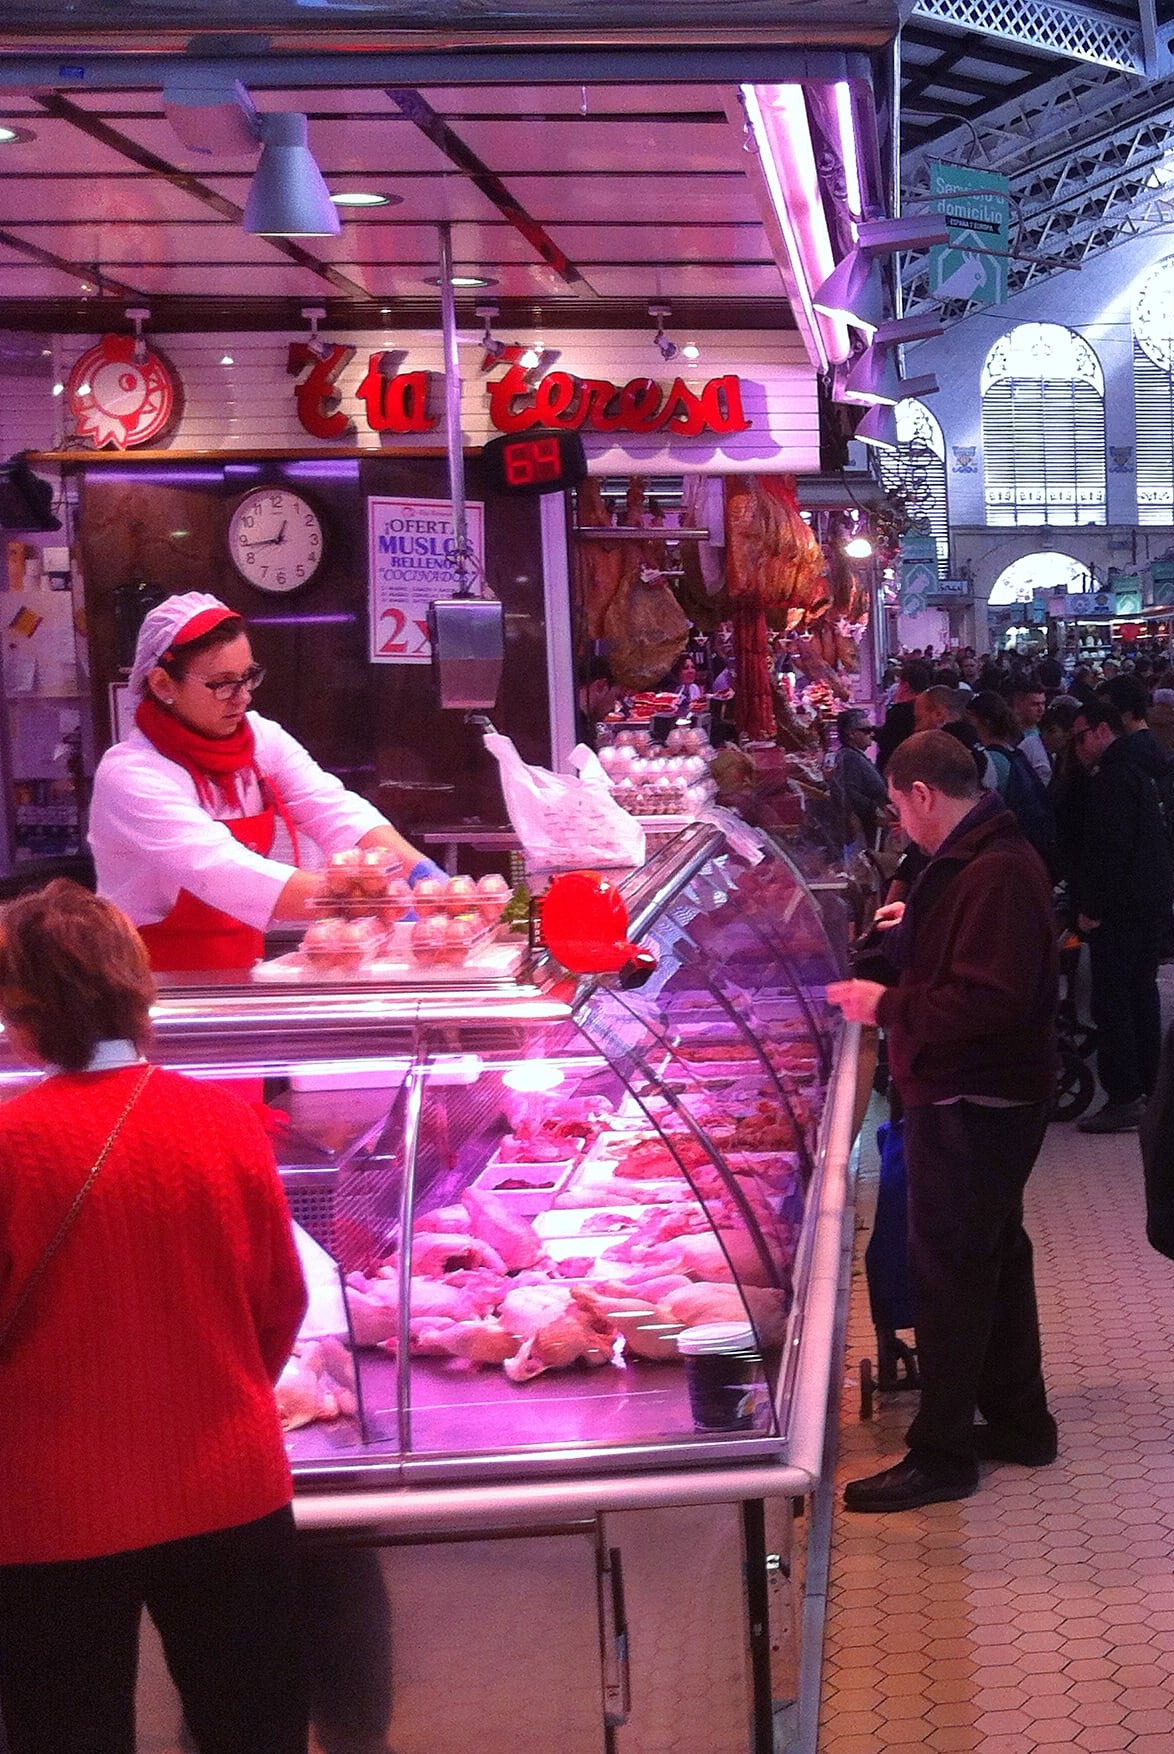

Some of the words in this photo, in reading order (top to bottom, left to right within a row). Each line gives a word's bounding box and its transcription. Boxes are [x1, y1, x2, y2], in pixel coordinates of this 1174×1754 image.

[937, 199, 1003, 224] domicilio
[482, 342, 753, 437] Teresa
[504, 437, 561, 486] 64
[270, 495, 283, 509] 12
[240, 515, 255, 529] 10
[304, 514, 315, 527] 2
[308, 533, 319, 546] 3
[246, 552, 256, 565] 8
[260, 565, 270, 579] 7
[276, 570, 287, 585] 6
[296, 564, 306, 577] 5
